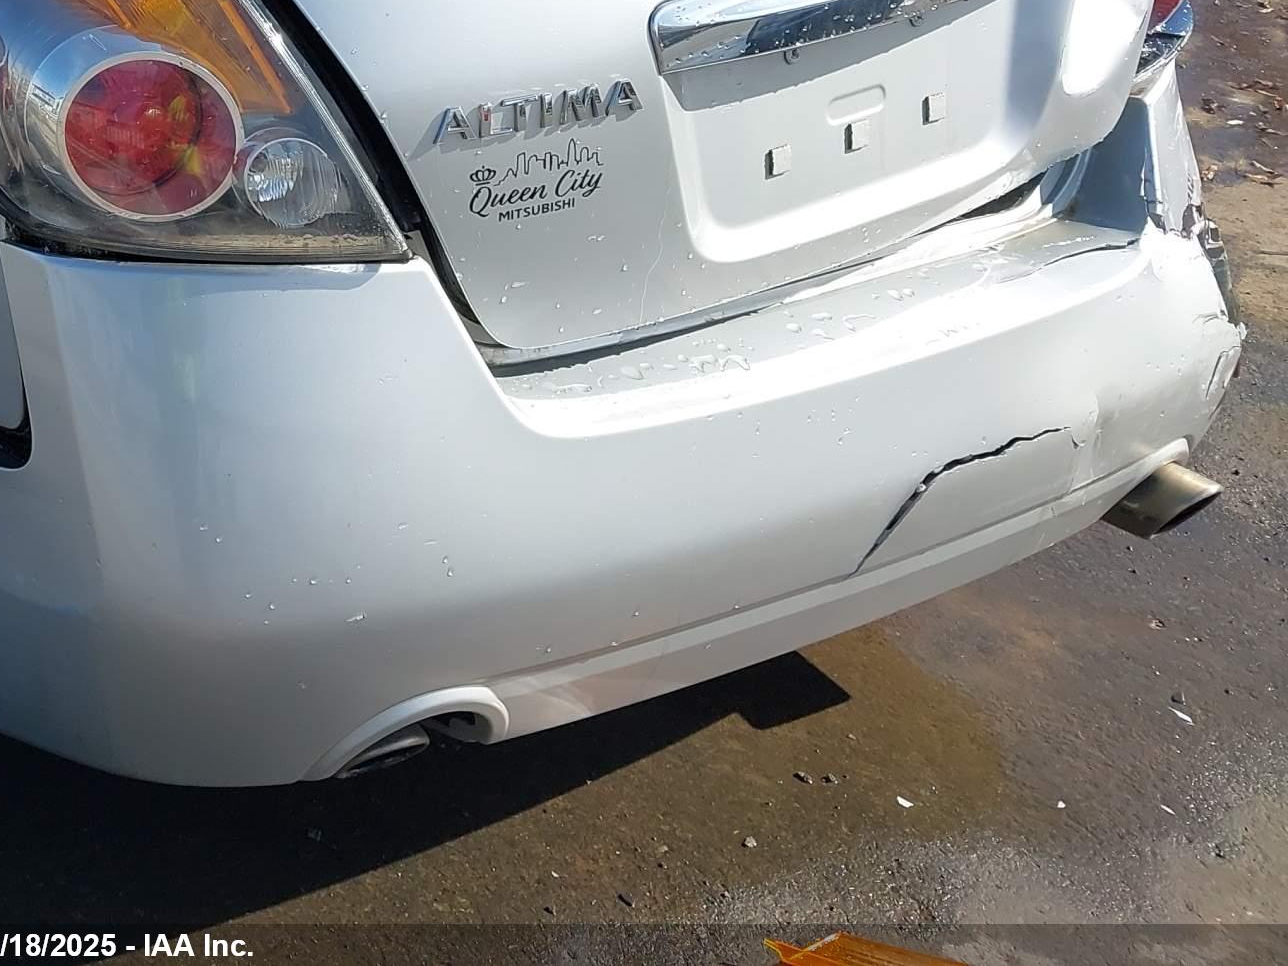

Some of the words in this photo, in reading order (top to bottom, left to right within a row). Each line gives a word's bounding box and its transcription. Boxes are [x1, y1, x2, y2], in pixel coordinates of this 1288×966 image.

[433, 77, 644, 145] ALTIMA
[469, 184, 548, 218] Queen
[555, 168, 605, 198] City
[498, 197, 576, 223] MITSUBISHI
